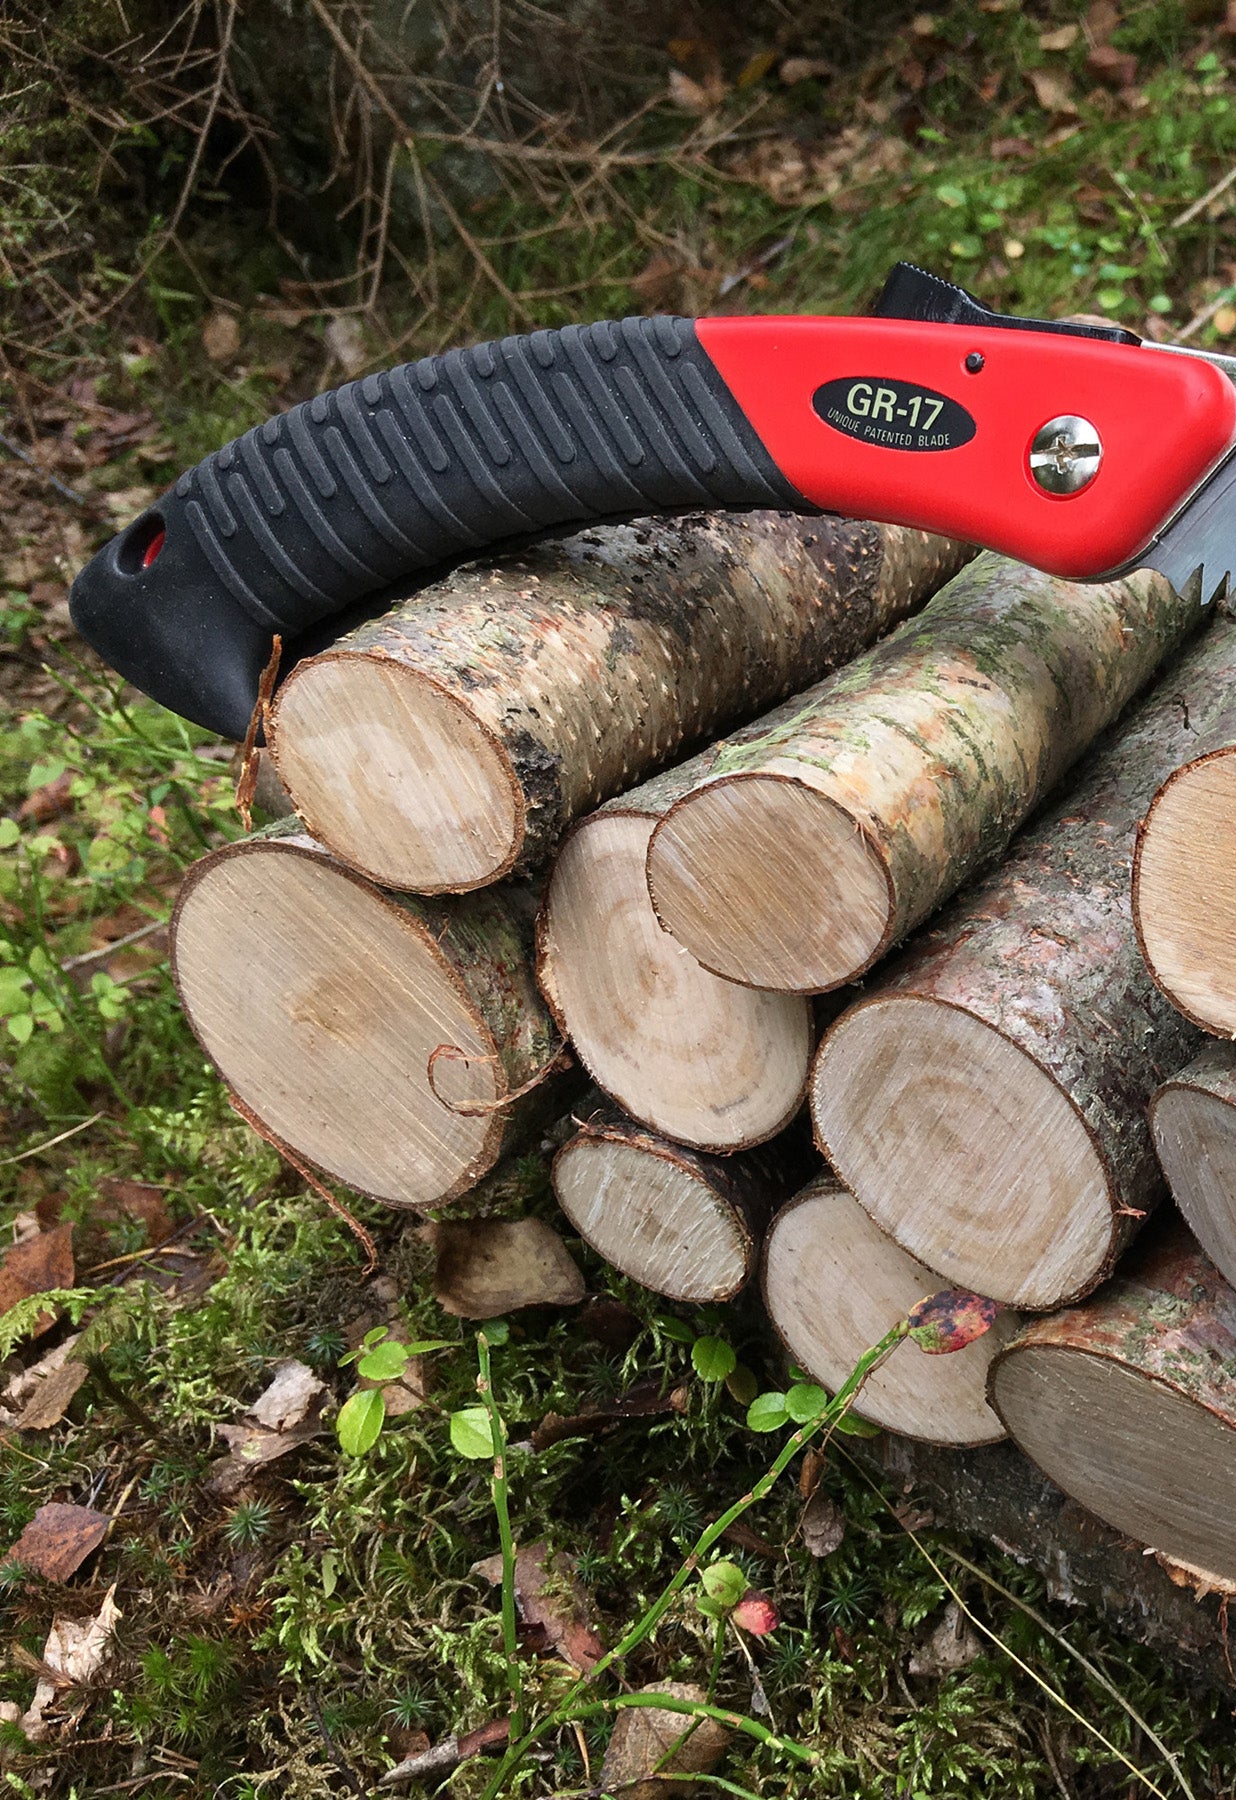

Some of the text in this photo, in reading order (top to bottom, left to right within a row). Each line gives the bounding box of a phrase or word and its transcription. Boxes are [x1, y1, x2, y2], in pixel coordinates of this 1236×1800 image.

[827, 407, 950, 447] UNIQUE PATENTED BLADE
[846, 383, 944, 431] GR-17
